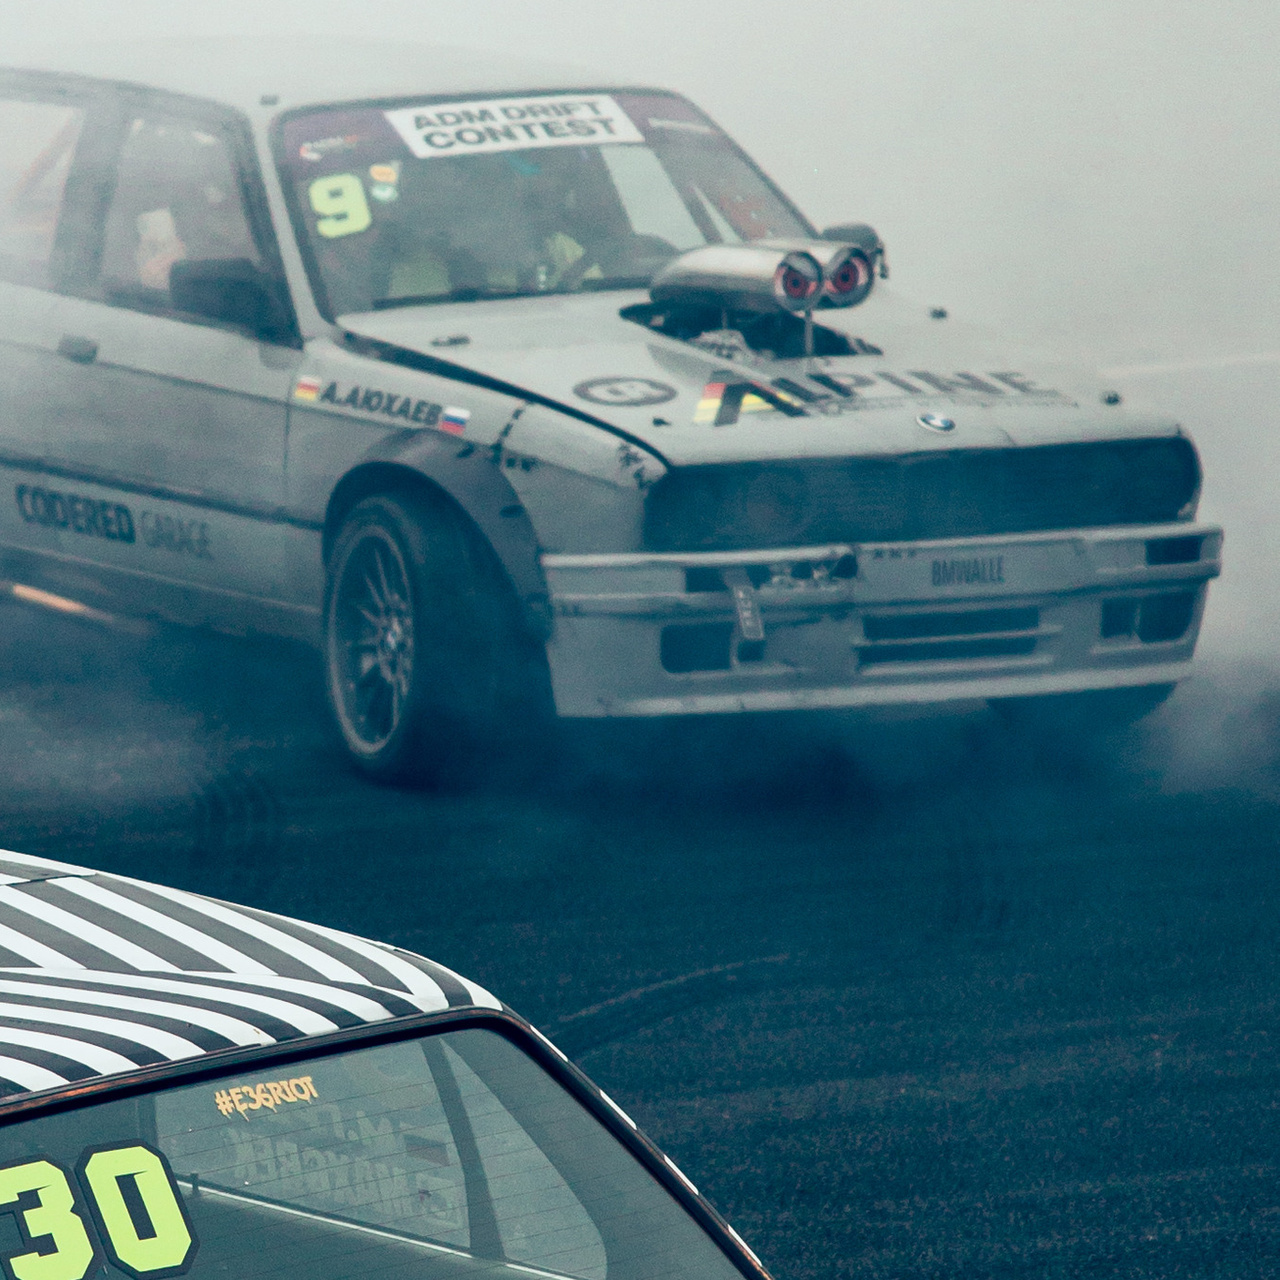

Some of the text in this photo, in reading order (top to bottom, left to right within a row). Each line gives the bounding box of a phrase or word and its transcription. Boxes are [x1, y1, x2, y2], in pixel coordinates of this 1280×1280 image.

[413, 101, 603, 130] ADM DRIFT
[423, 118, 617, 150] CONTEST
[307, 173, 372, 239] 9
[214, 1075, 319, 1122] #E36RIOT
